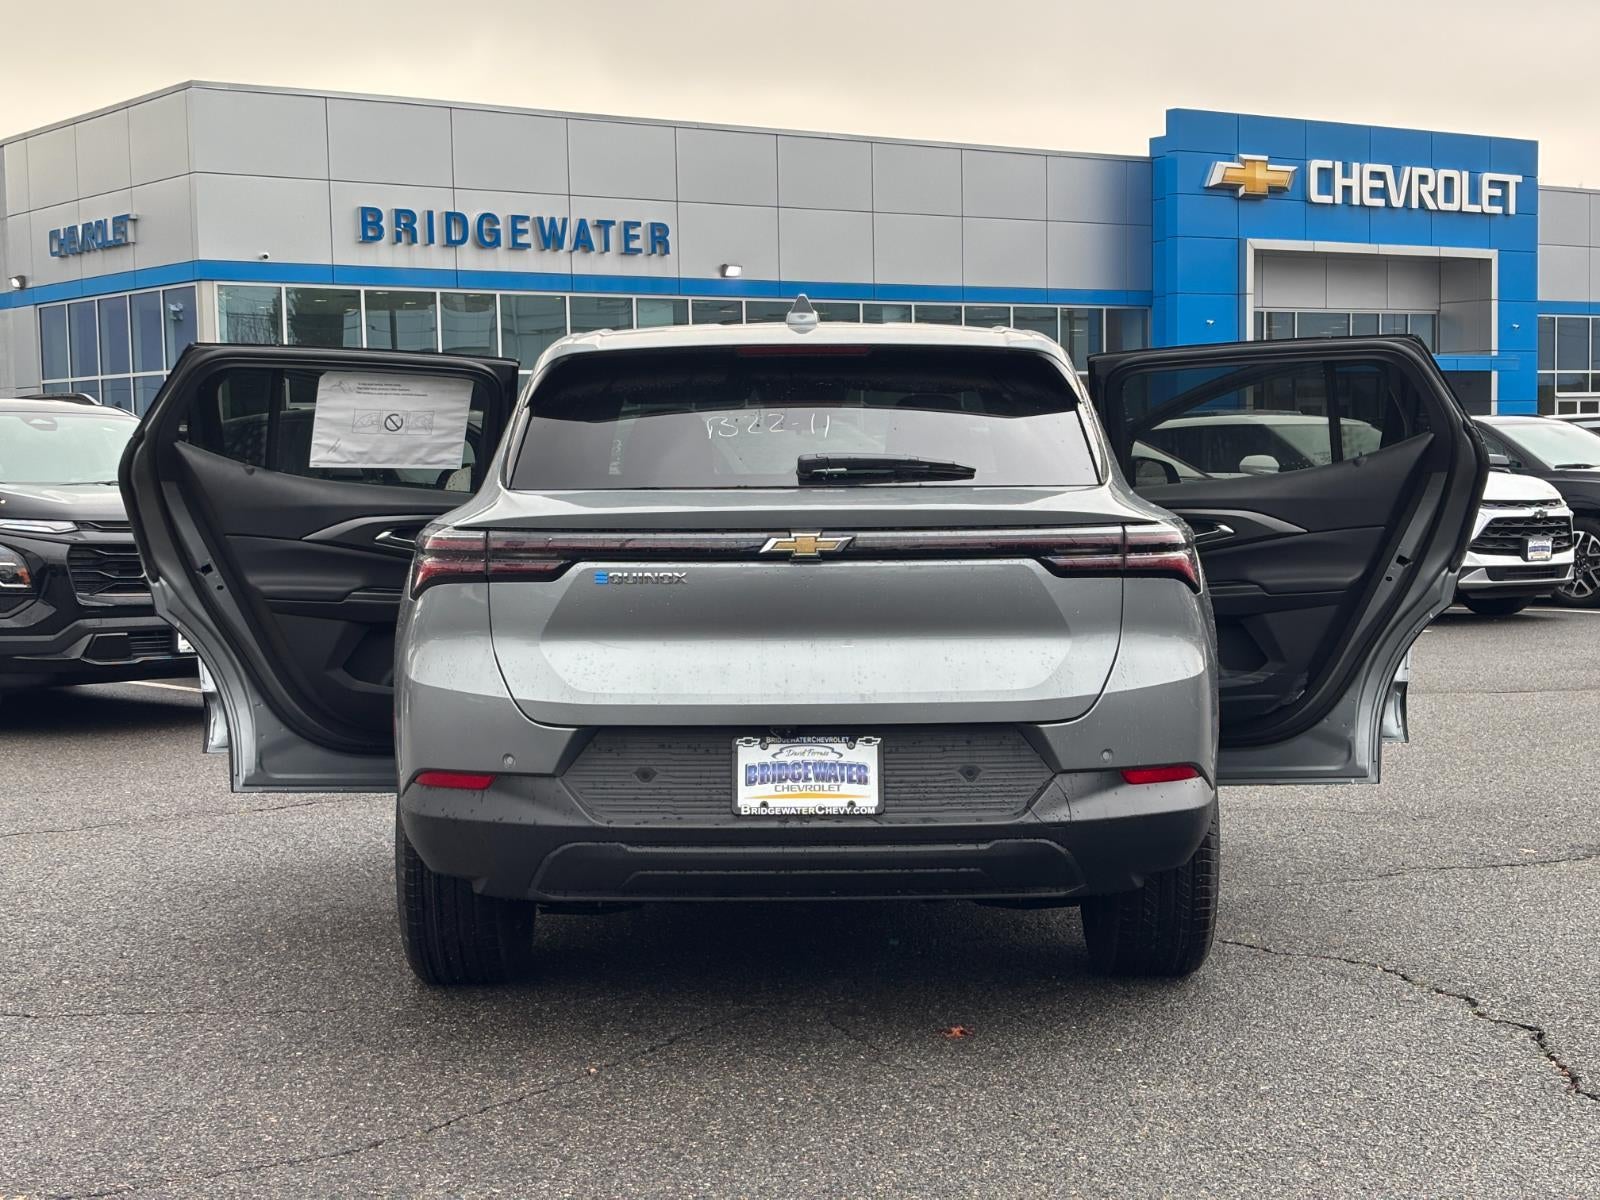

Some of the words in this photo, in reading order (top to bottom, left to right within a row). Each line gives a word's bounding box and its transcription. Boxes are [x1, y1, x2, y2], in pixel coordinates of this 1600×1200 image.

[1308, 159, 1522, 215] CHEVROLET
[49, 213, 137, 256] CHEVROLET
[357, 206, 671, 256] BRIDGEWATER
[594, 569, 688, 585] EQUINOX
[745, 760, 869, 786] BRIDGEWATER
[774, 784, 842, 792] CHEVROLET
